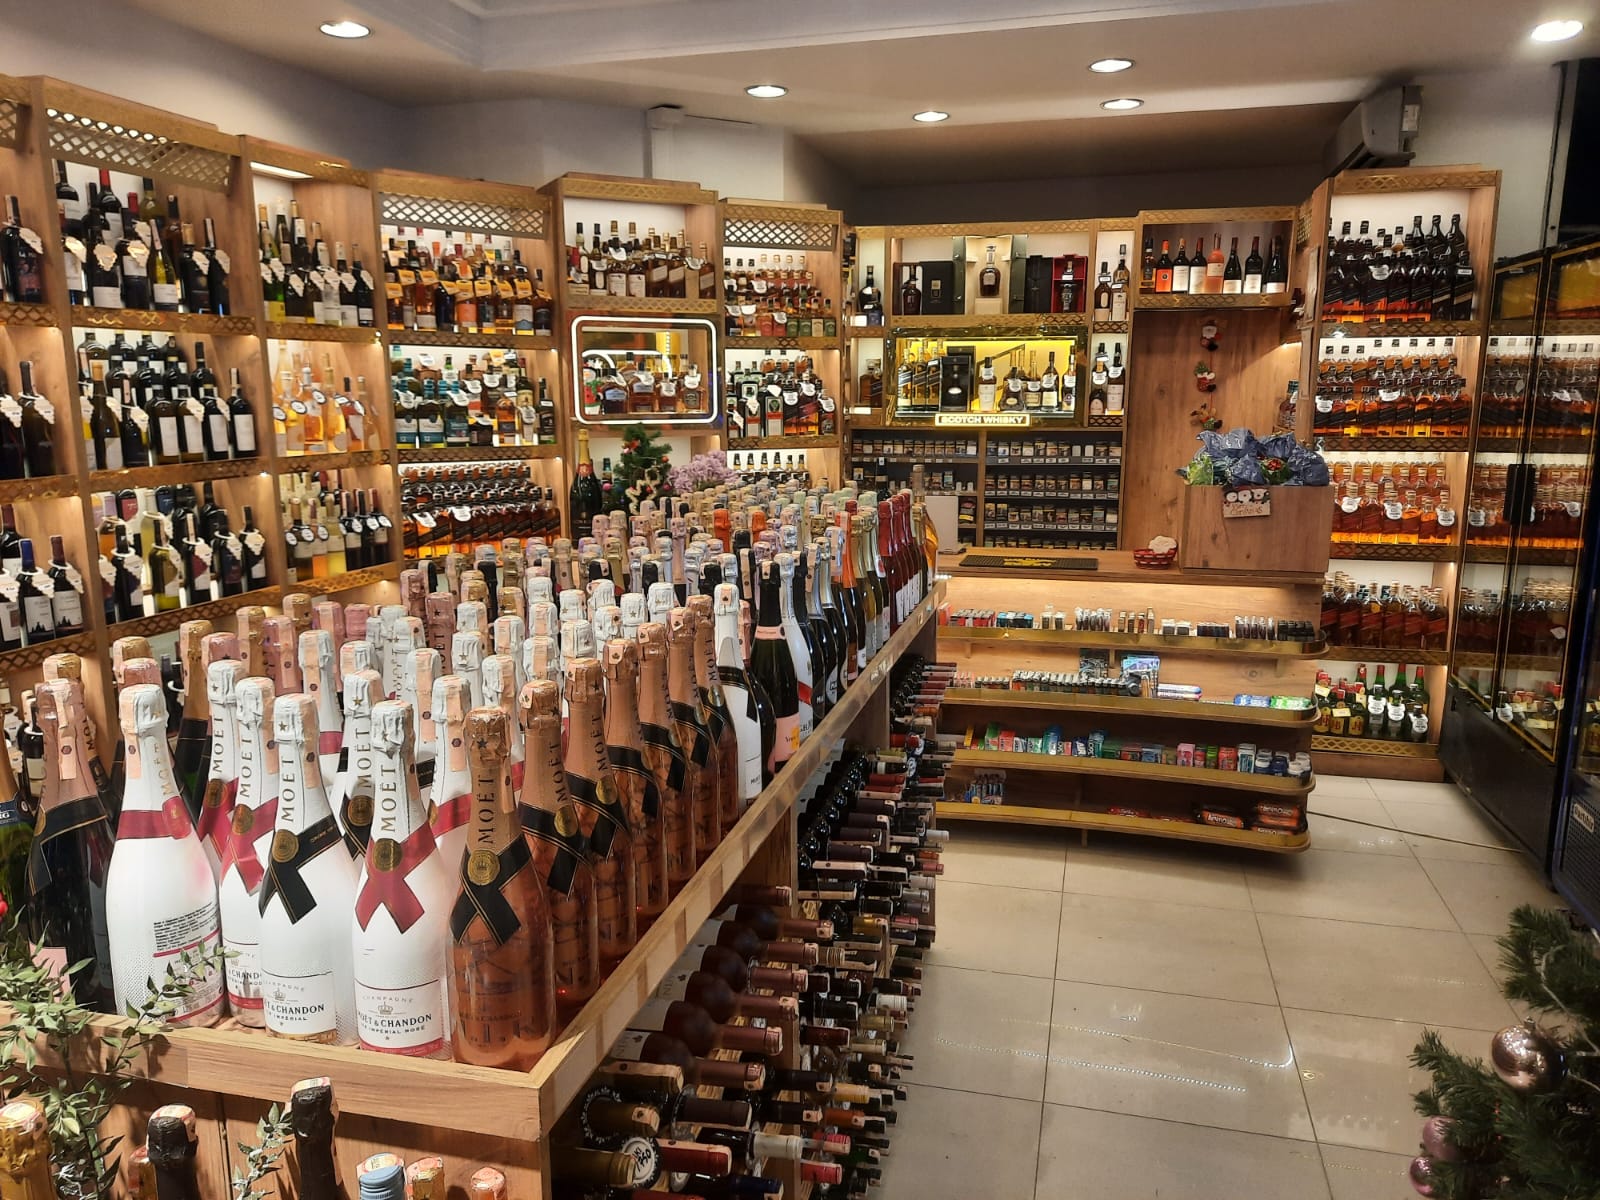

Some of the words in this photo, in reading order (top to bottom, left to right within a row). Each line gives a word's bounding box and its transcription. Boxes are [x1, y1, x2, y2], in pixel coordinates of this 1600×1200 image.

[941, 415, 981, 424] SCOTCH
[982, 415, 1024, 424] WHISKY
[276, 1003, 325, 1016] CHANDON
[380, 1013, 433, 1028] CHANDON
